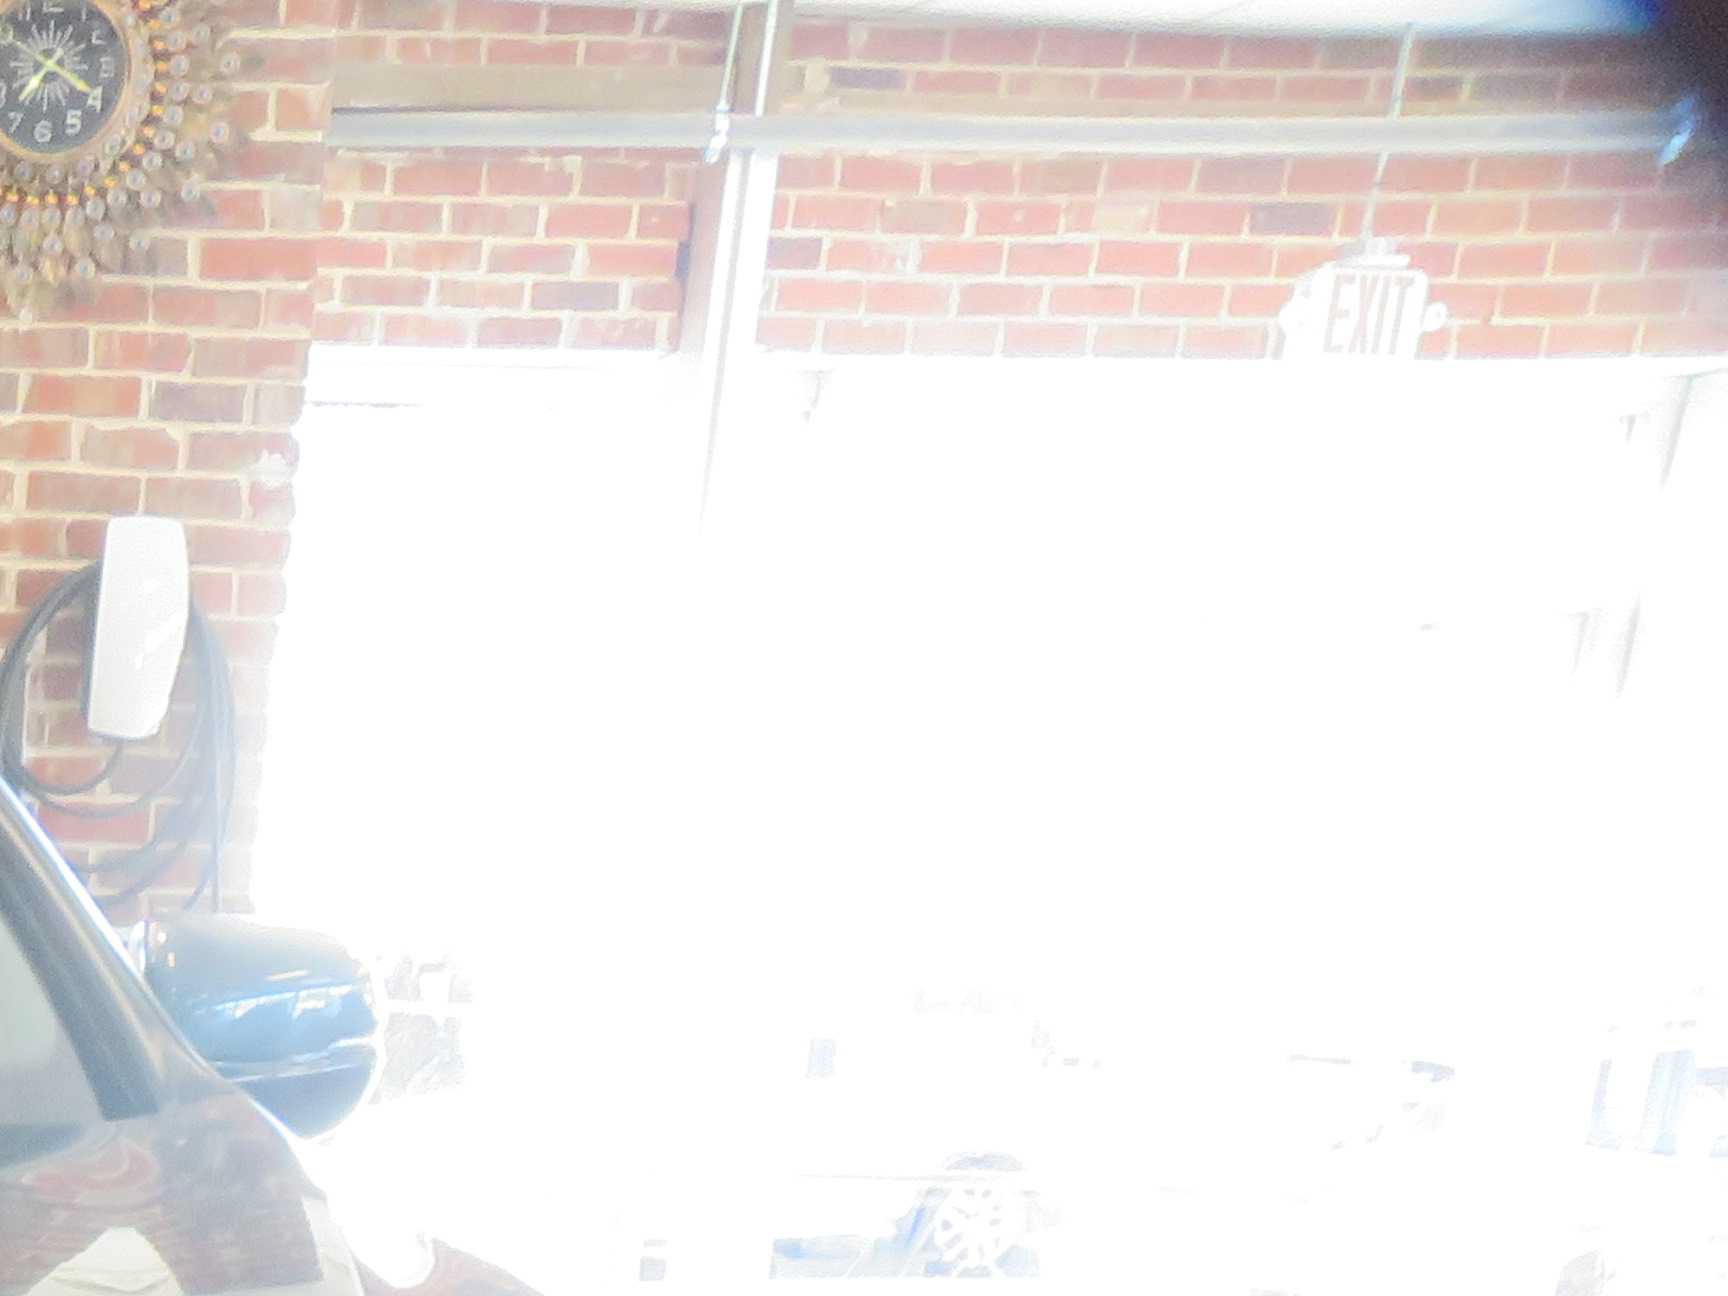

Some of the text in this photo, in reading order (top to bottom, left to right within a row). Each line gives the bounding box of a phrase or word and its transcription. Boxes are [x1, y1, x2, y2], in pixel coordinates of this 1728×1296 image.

[86, 85, 104, 113] 4
[7, 111, 24, 134] 7
[33, 119, 53, 143] 6
[64, 109, 82, 137] 5
[1323, 272, 1416, 355] EXIT
